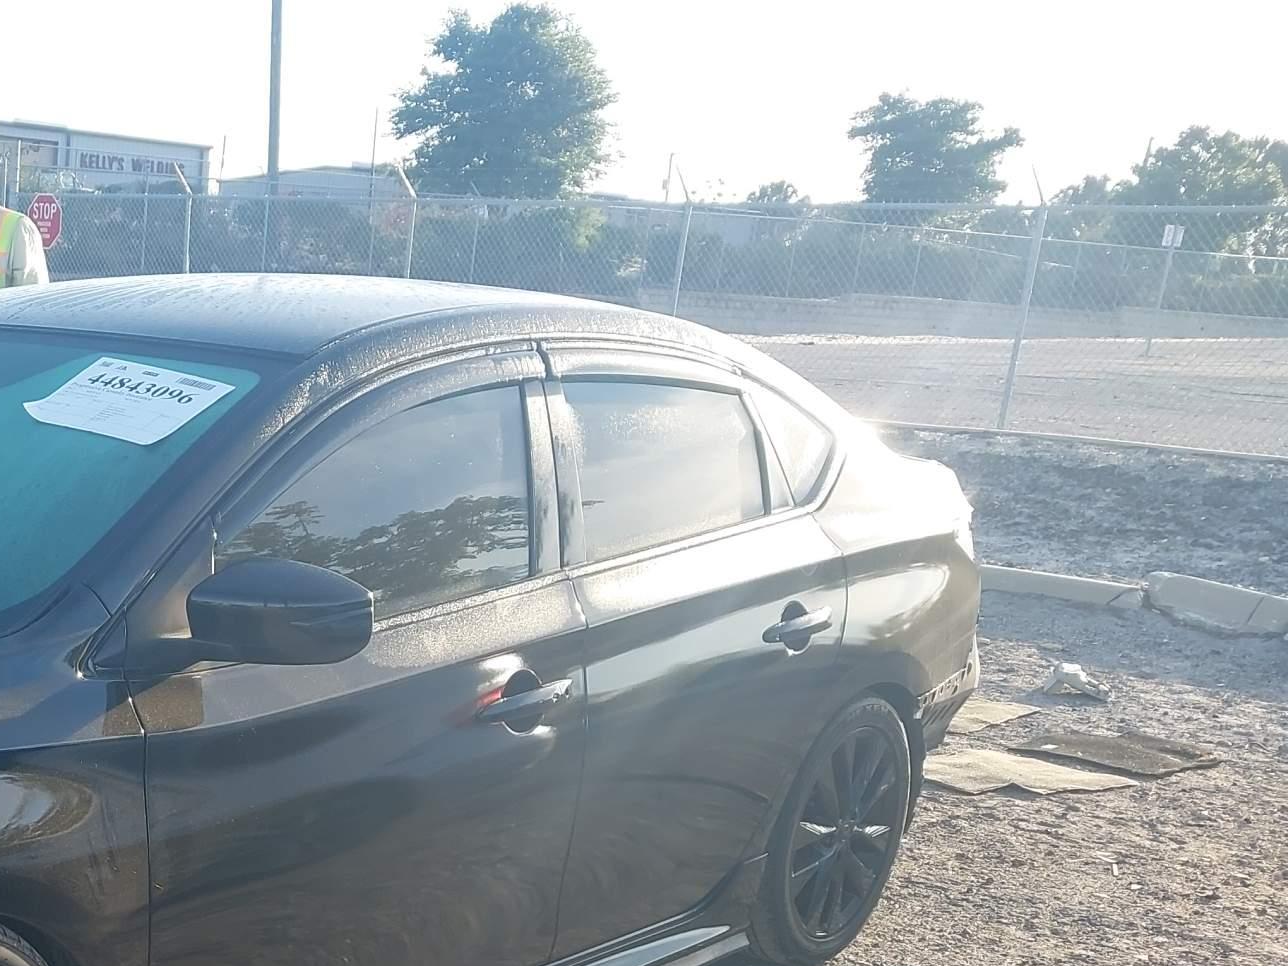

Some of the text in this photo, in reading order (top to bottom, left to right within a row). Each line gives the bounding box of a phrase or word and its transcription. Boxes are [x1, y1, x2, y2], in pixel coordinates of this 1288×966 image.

[80, 152, 125, 171] KELLY'S
[32, 202, 57, 220] STOP
[88, 373, 200, 404] 44843096
